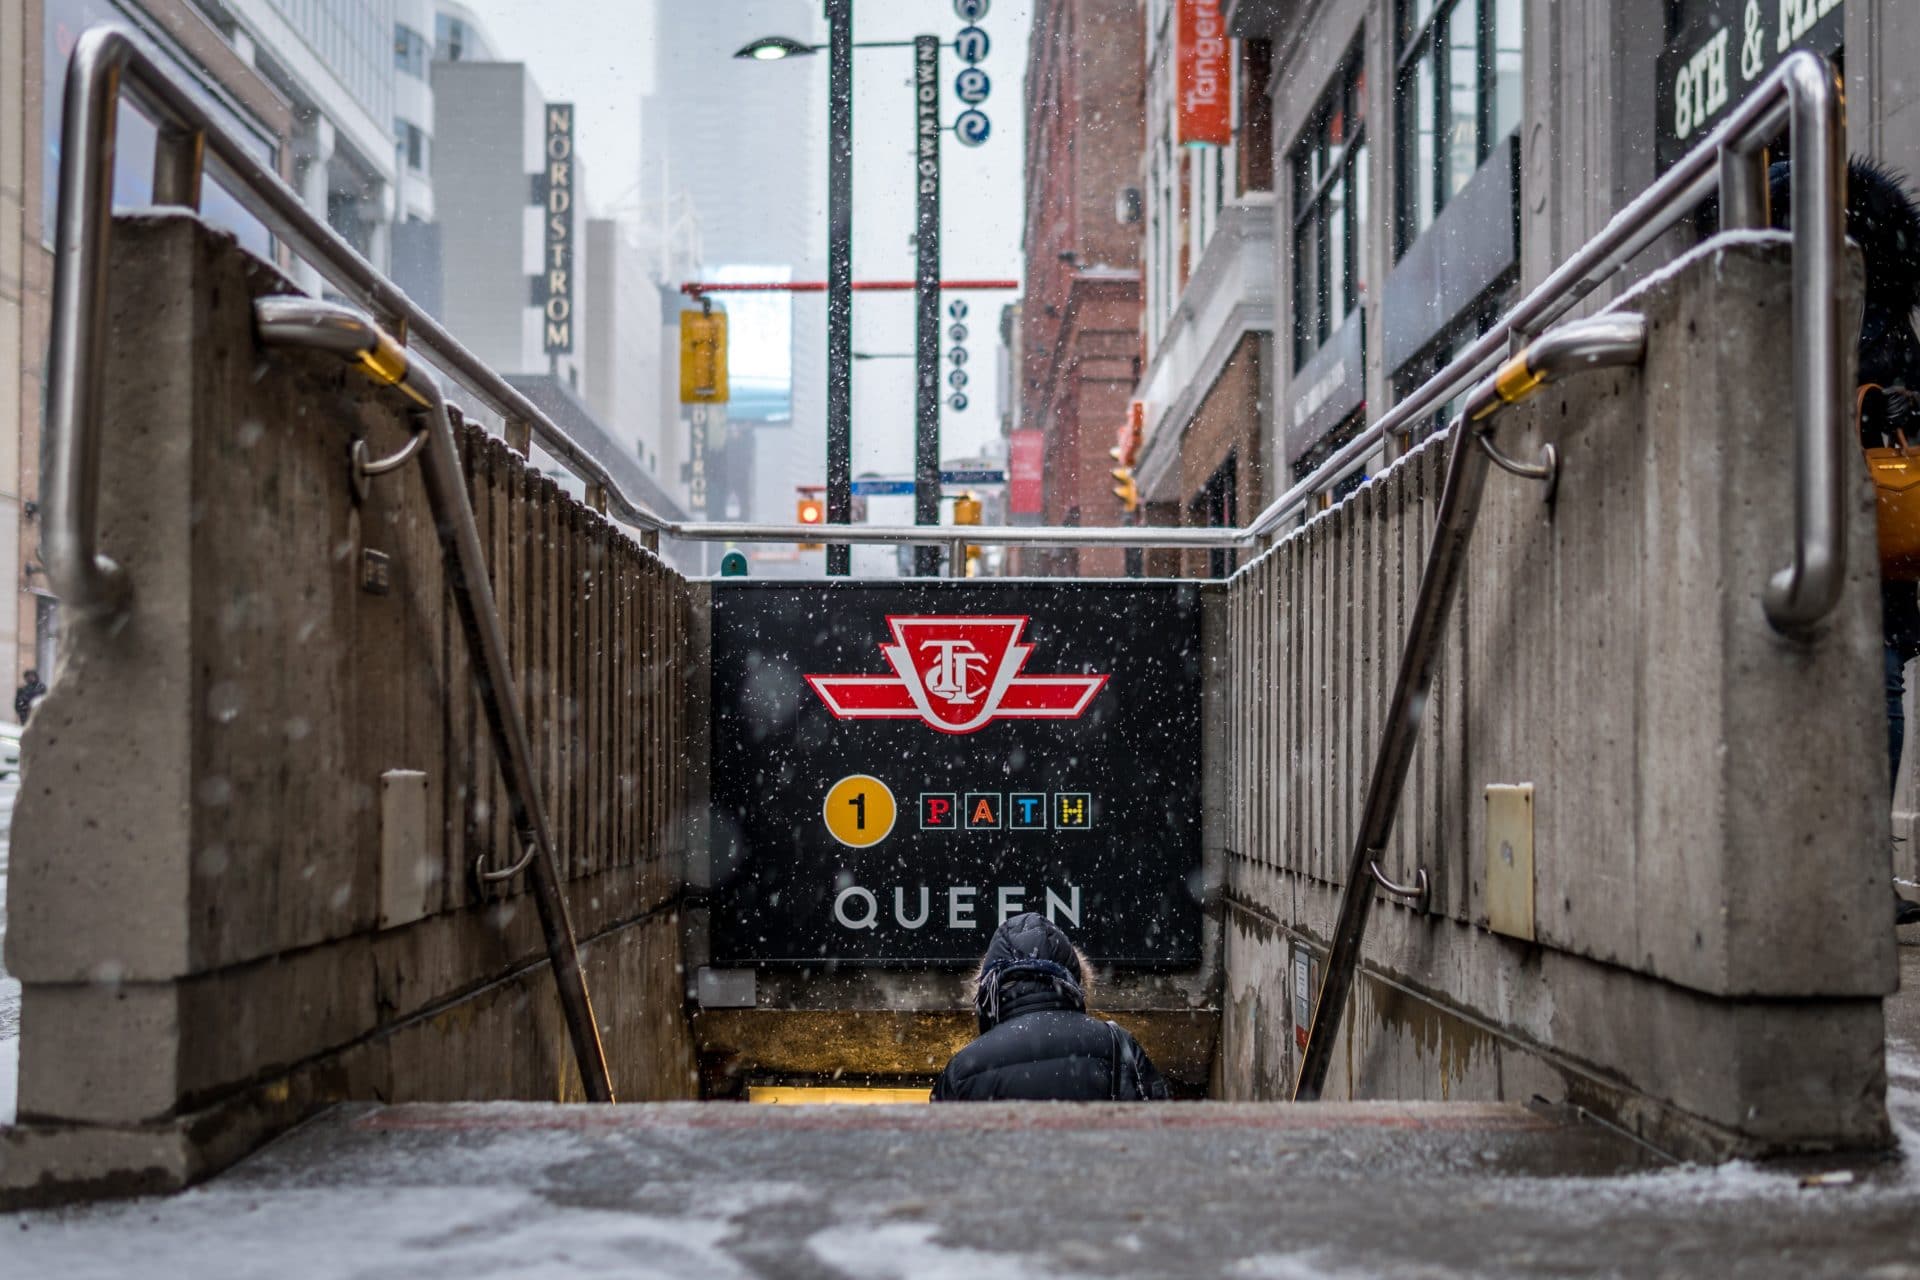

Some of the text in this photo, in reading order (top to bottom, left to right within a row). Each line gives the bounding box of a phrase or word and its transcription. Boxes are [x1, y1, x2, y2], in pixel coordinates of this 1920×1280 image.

[918, 45, 937, 195] DOWNTOWN
[1675, 27, 1728, 140] 8TH
[1741, 0, 1764, 81] &
[547, 110, 570, 348] NORDSTROM
[848, 793, 1083, 830] 1 PATH
[834, 886, 1081, 930] QUEEN
